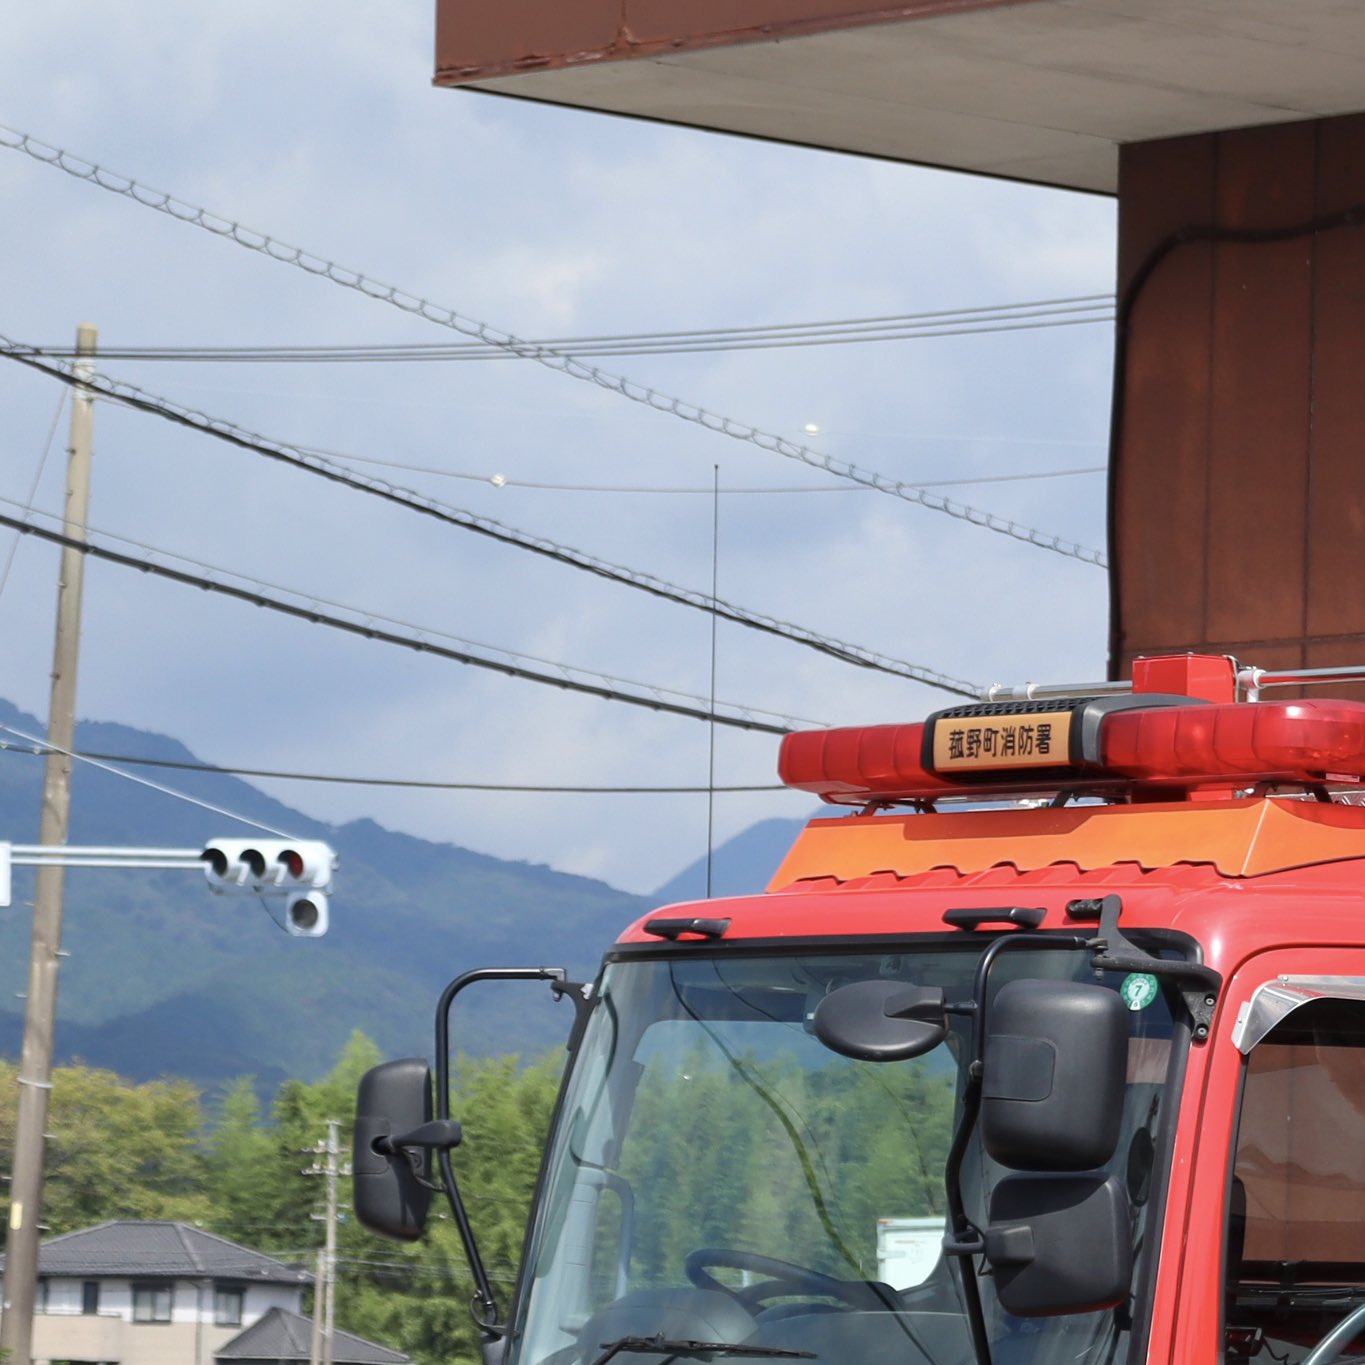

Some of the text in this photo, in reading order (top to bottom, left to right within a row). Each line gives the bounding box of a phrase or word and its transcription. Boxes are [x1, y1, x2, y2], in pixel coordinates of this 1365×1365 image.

[949, 724, 1052, 760] 菰野町消防署
[1134, 985, 1143, 997] 7
